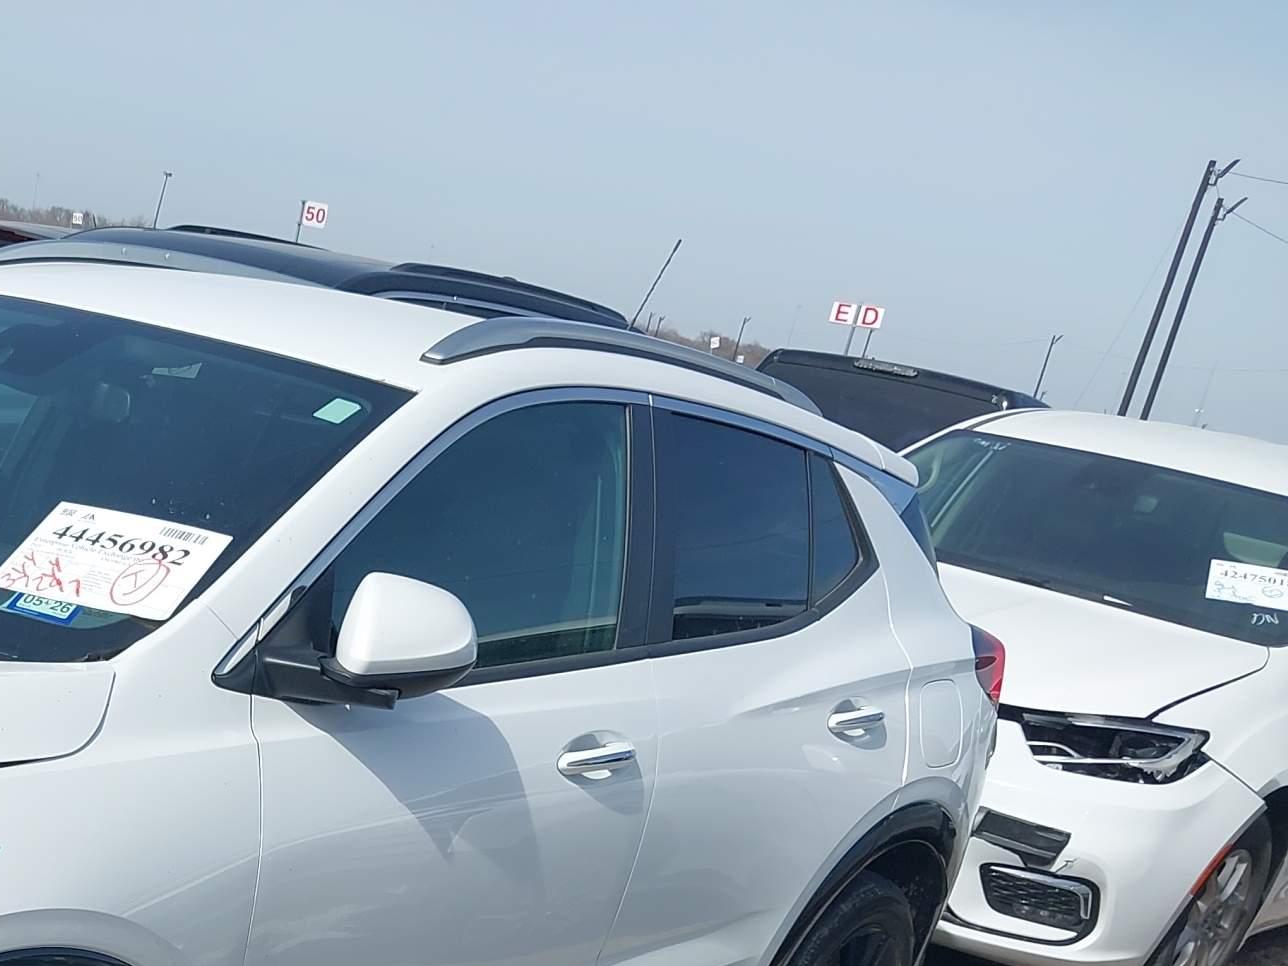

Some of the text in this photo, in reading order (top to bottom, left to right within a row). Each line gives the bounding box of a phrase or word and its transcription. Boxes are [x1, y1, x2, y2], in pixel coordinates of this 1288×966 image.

[304, 205, 326, 224] 50
[834, 303, 852, 322] E
[861, 307, 879, 326] D
[51, 524, 191, 567] 44456982
[49, 600, 73, 613] 26
